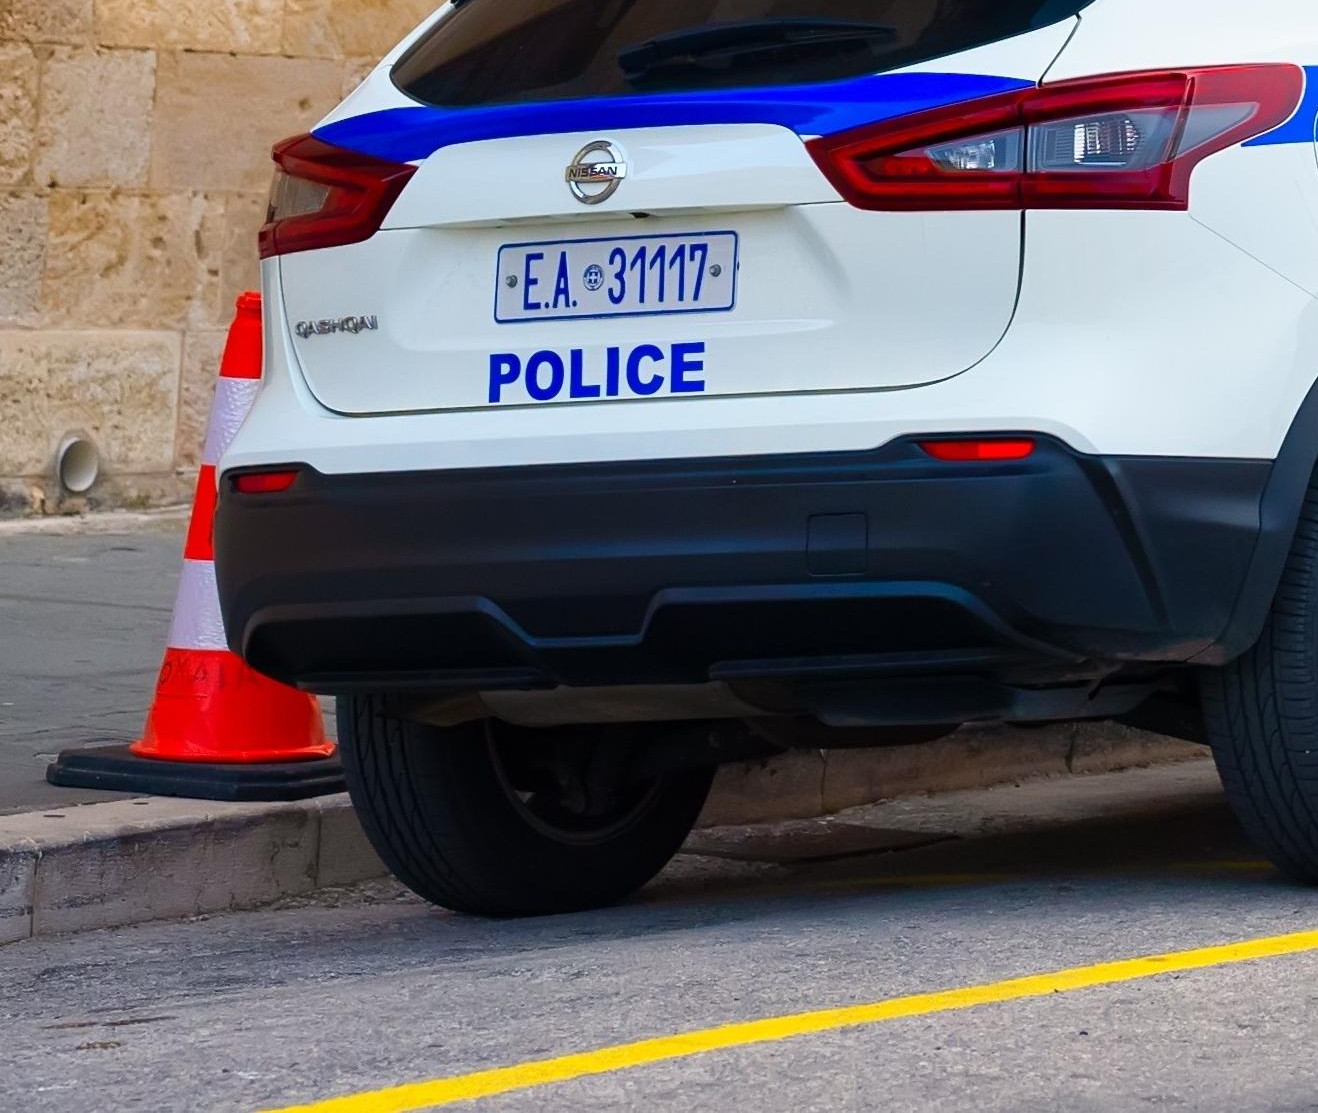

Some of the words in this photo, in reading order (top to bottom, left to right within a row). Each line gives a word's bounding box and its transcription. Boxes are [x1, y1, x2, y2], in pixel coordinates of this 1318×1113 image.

[569, 166, 618, 178] NISSAN
[607, 243, 708, 305] 31117
[295, 315, 378, 338] QASHQAI
[488, 342, 705, 403] POLICE
